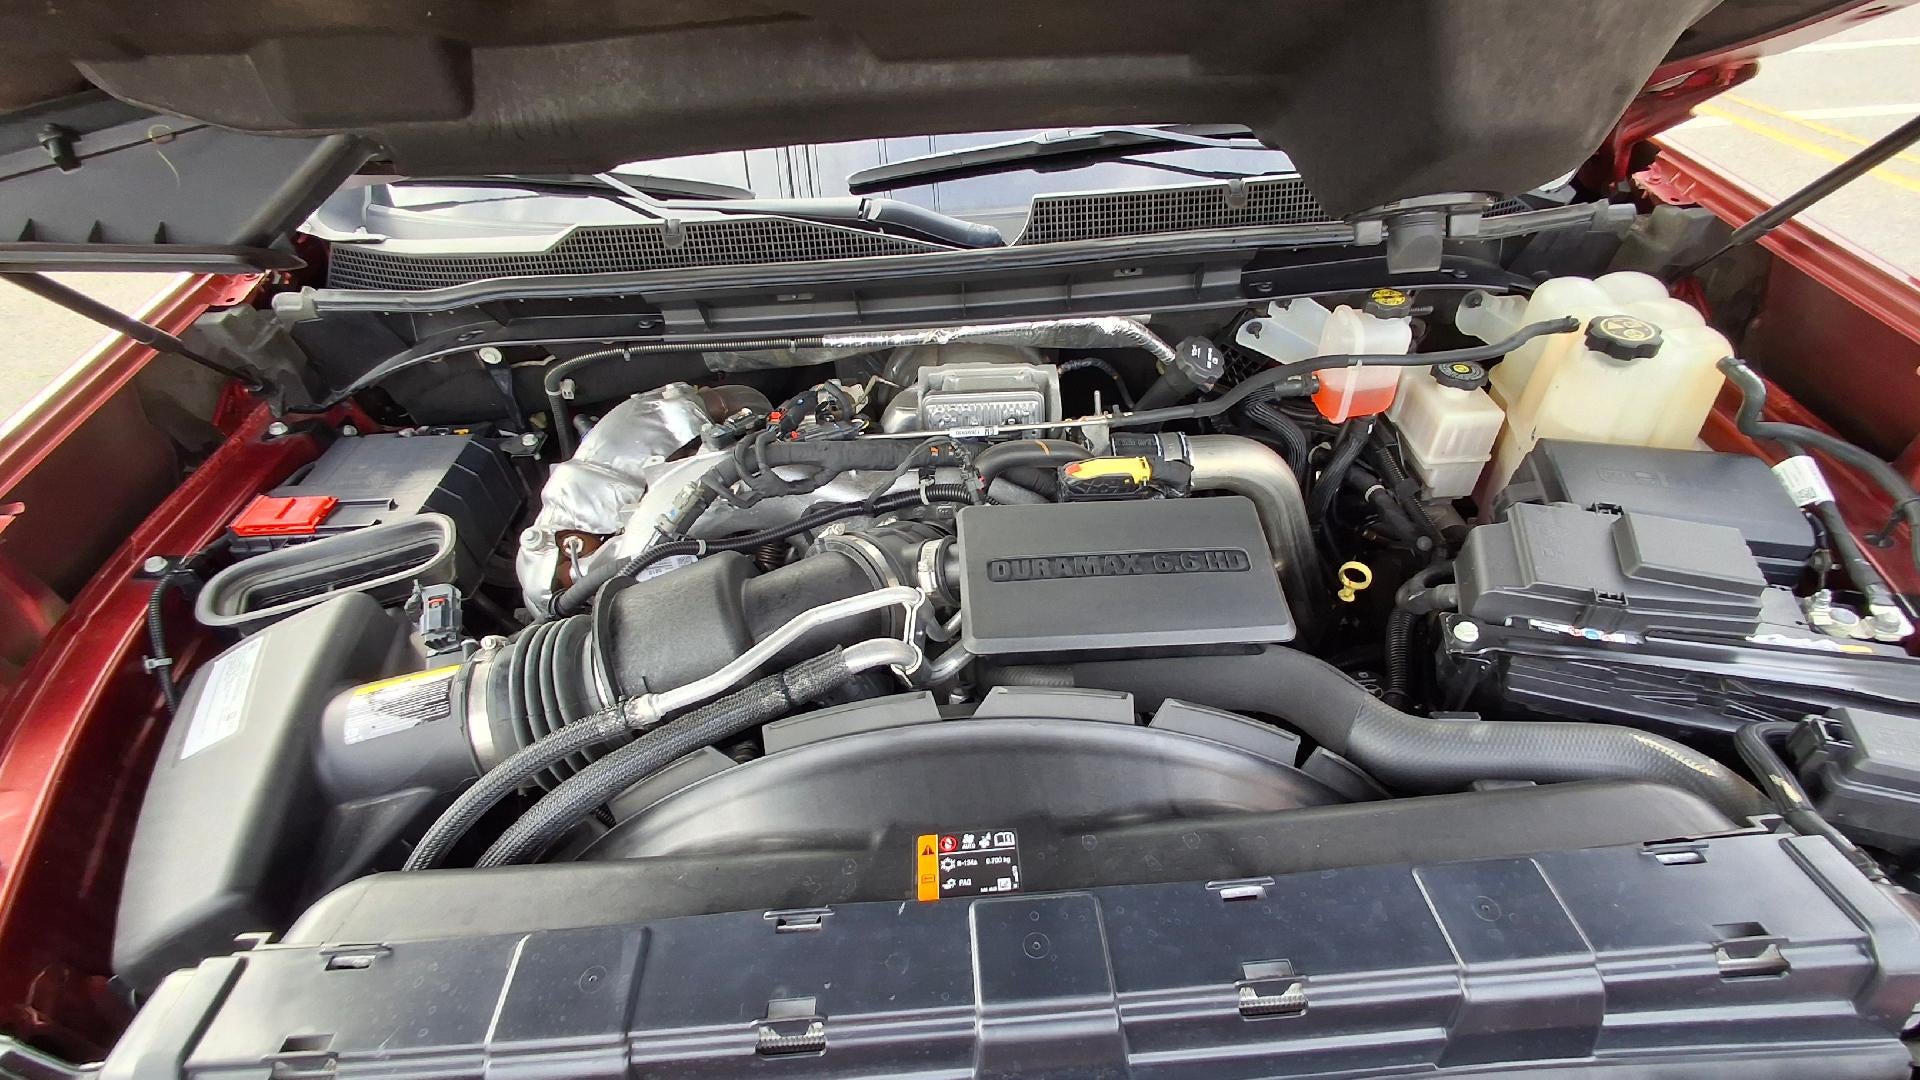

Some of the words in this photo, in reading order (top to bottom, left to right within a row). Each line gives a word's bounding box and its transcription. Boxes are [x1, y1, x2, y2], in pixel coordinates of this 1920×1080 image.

[992, 554, 1142, 577] DURAMAX
[1153, 553, 1201, 572] 6.6
[1205, 551, 1248, 570] HD
